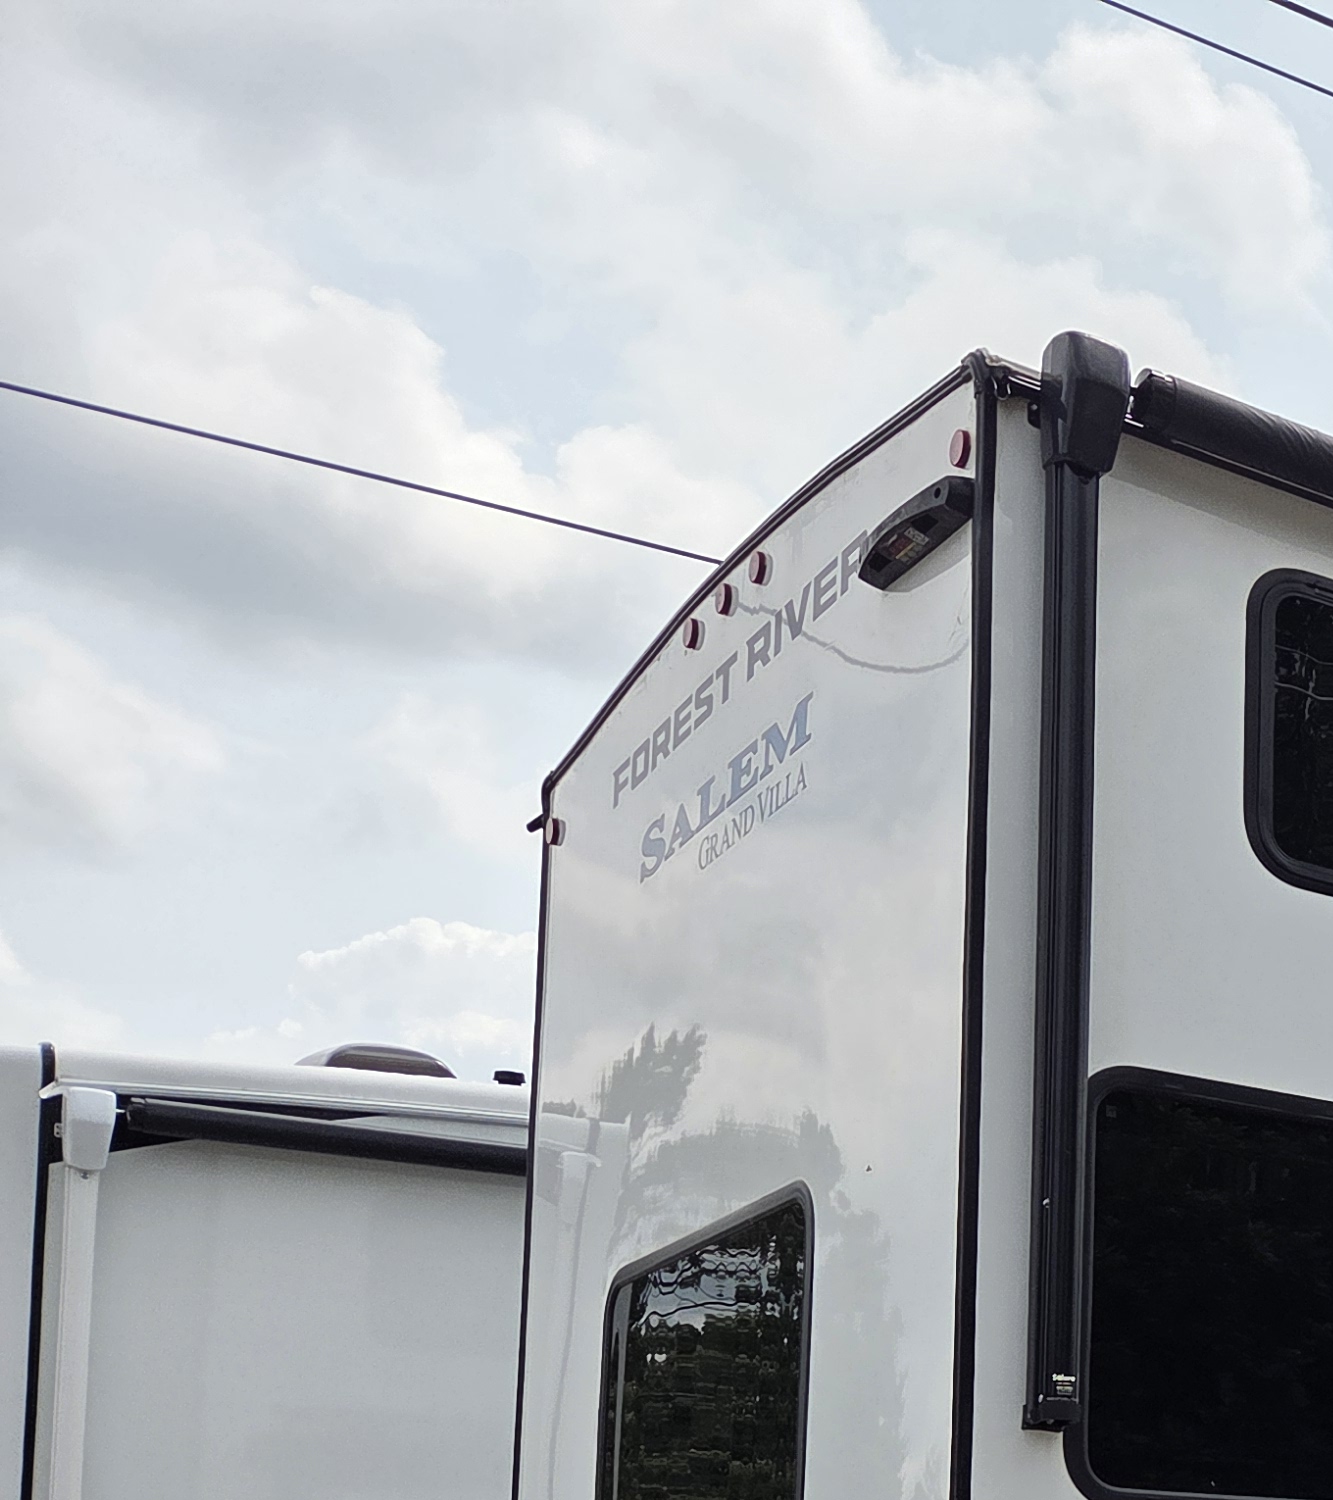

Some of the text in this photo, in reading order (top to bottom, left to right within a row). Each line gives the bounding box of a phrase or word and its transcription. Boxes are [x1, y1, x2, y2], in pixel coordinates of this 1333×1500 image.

[612, 650, 739, 810] FOREST
[639, 690, 814, 885] SALEM
[698, 761, 808, 871] GRAND VILLA
